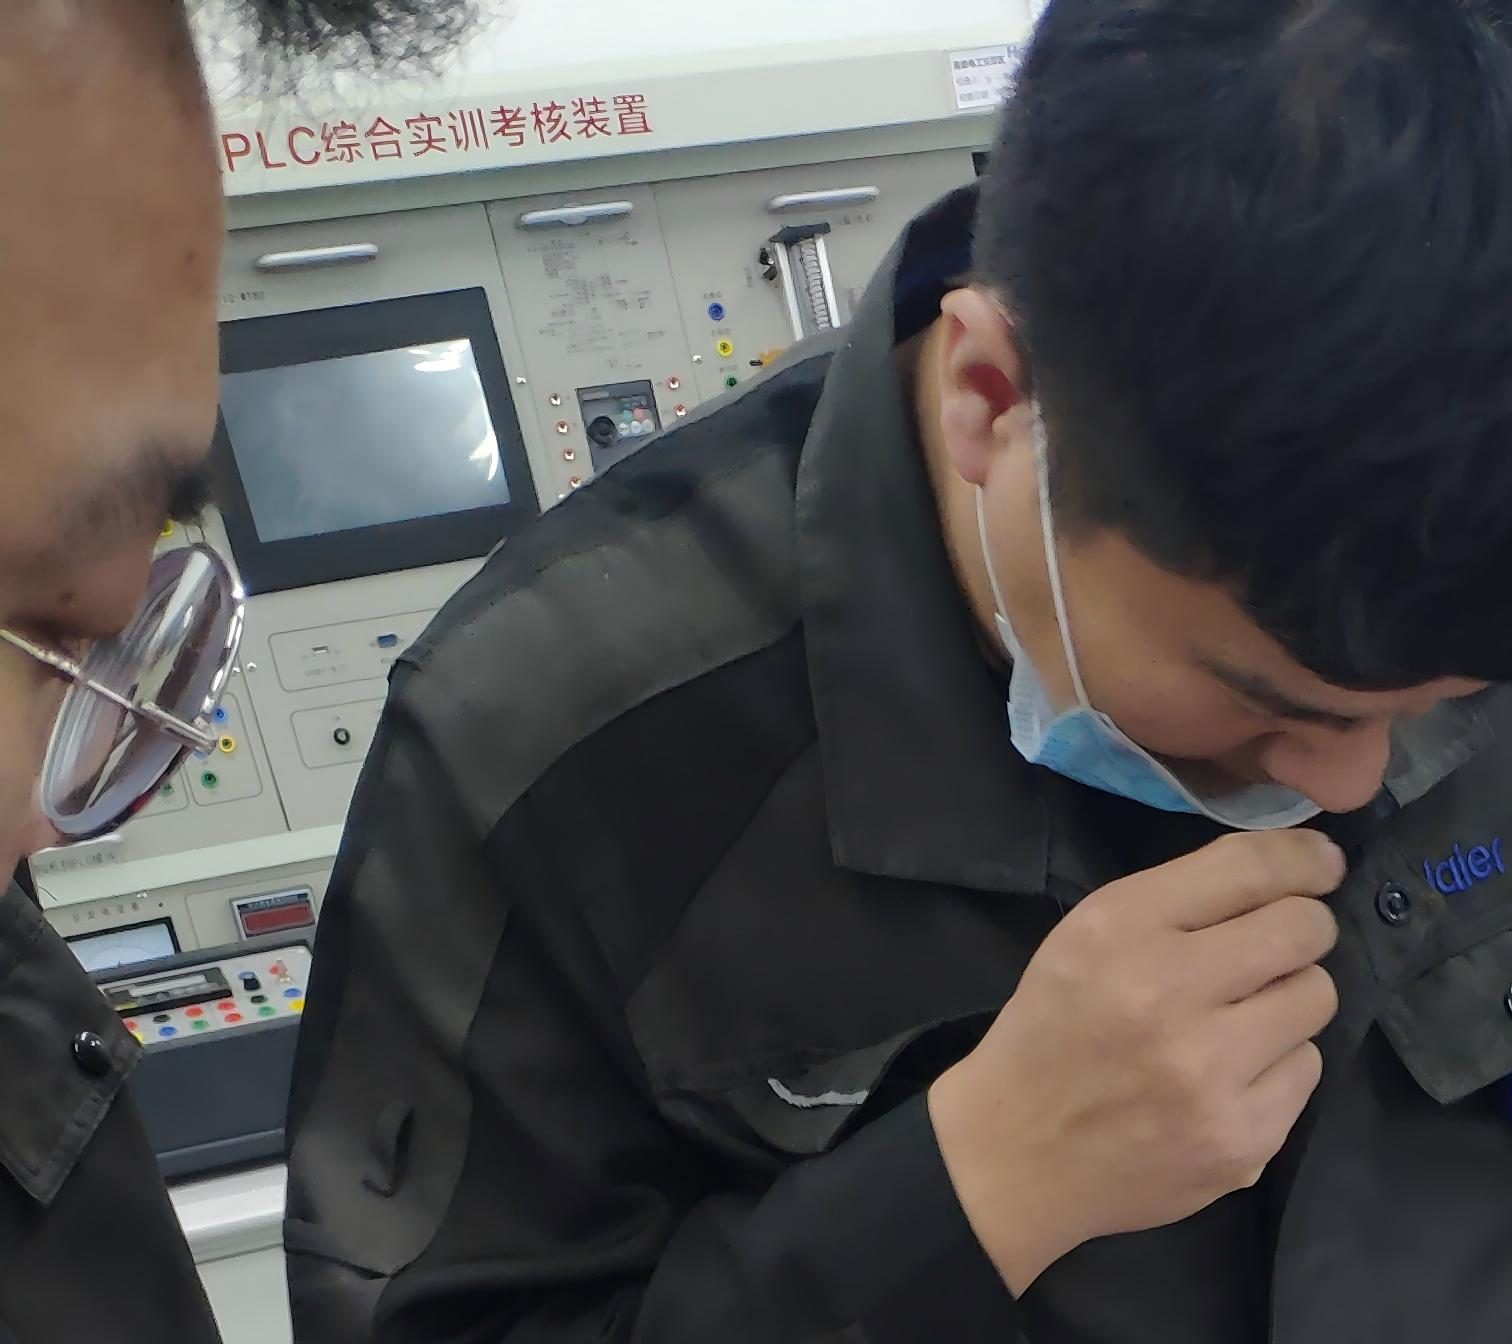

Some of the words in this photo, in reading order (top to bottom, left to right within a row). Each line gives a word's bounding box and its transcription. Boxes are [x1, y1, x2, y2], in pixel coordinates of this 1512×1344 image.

[221, 94, 654, 172] PLC综合实训考核装置
